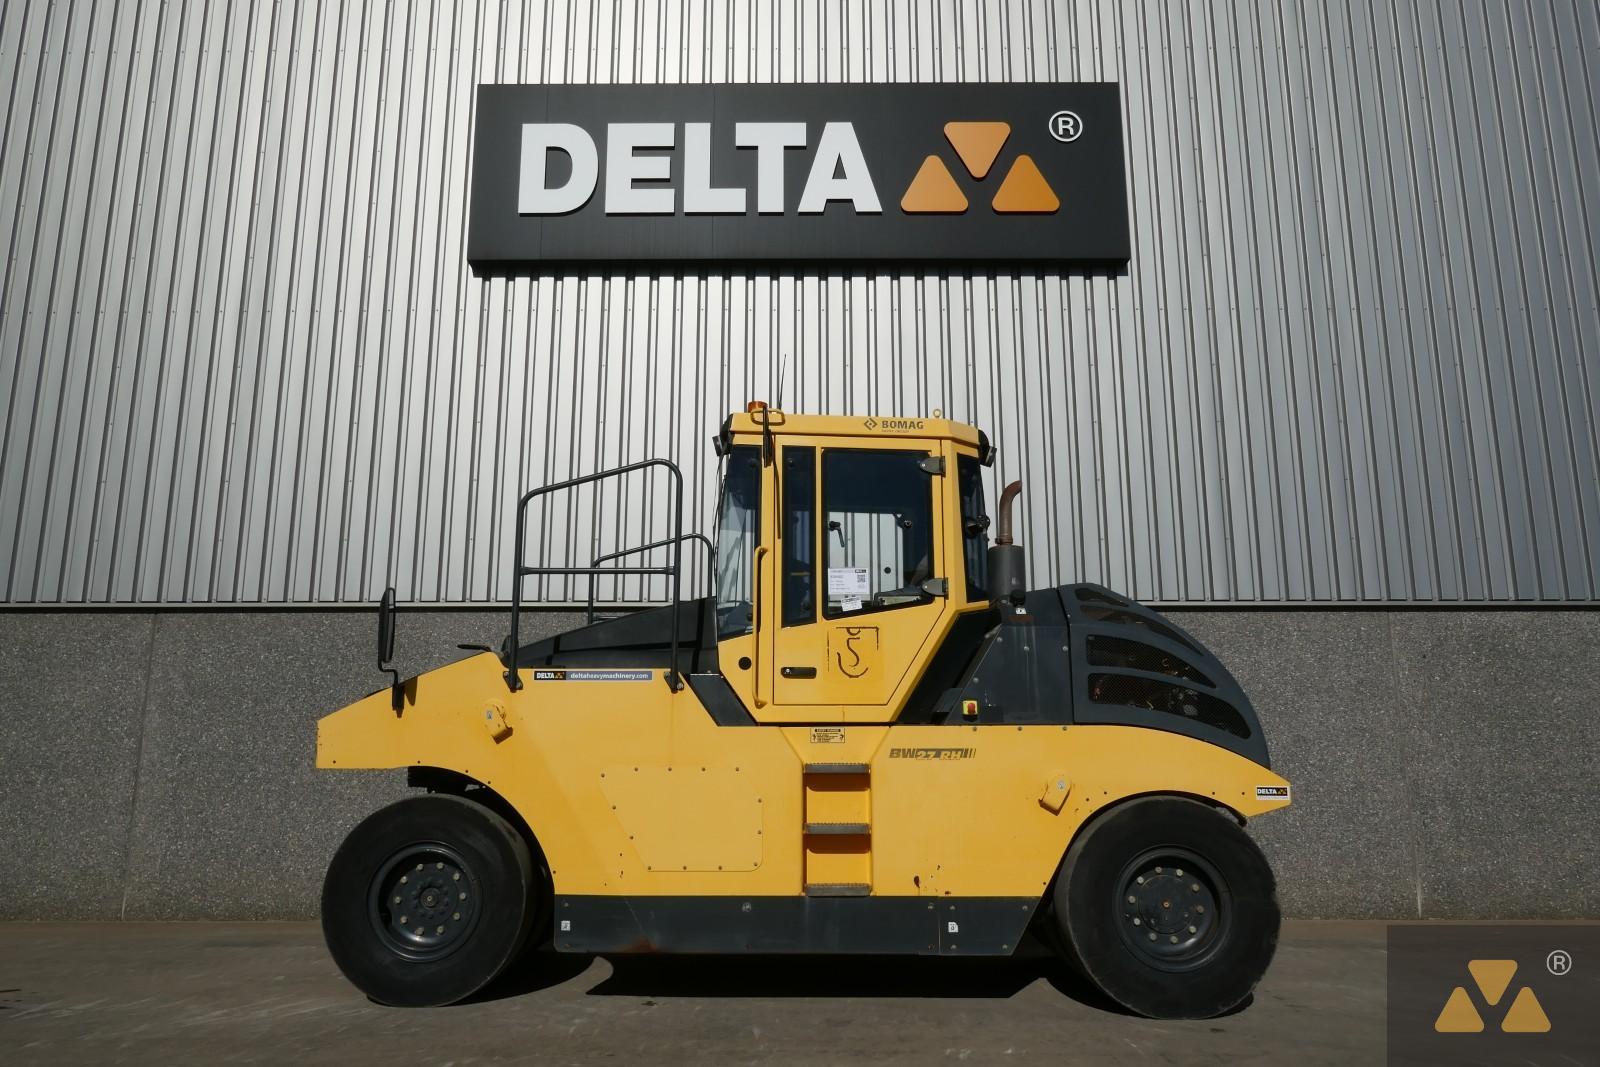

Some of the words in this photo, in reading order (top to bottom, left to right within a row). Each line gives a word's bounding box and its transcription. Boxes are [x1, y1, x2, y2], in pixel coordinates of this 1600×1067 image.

[517, 121, 882, 215] DELTA
[881, 420, 924, 430] BOMAG
[570, 671, 649, 680] deltaheavymachinery.com
